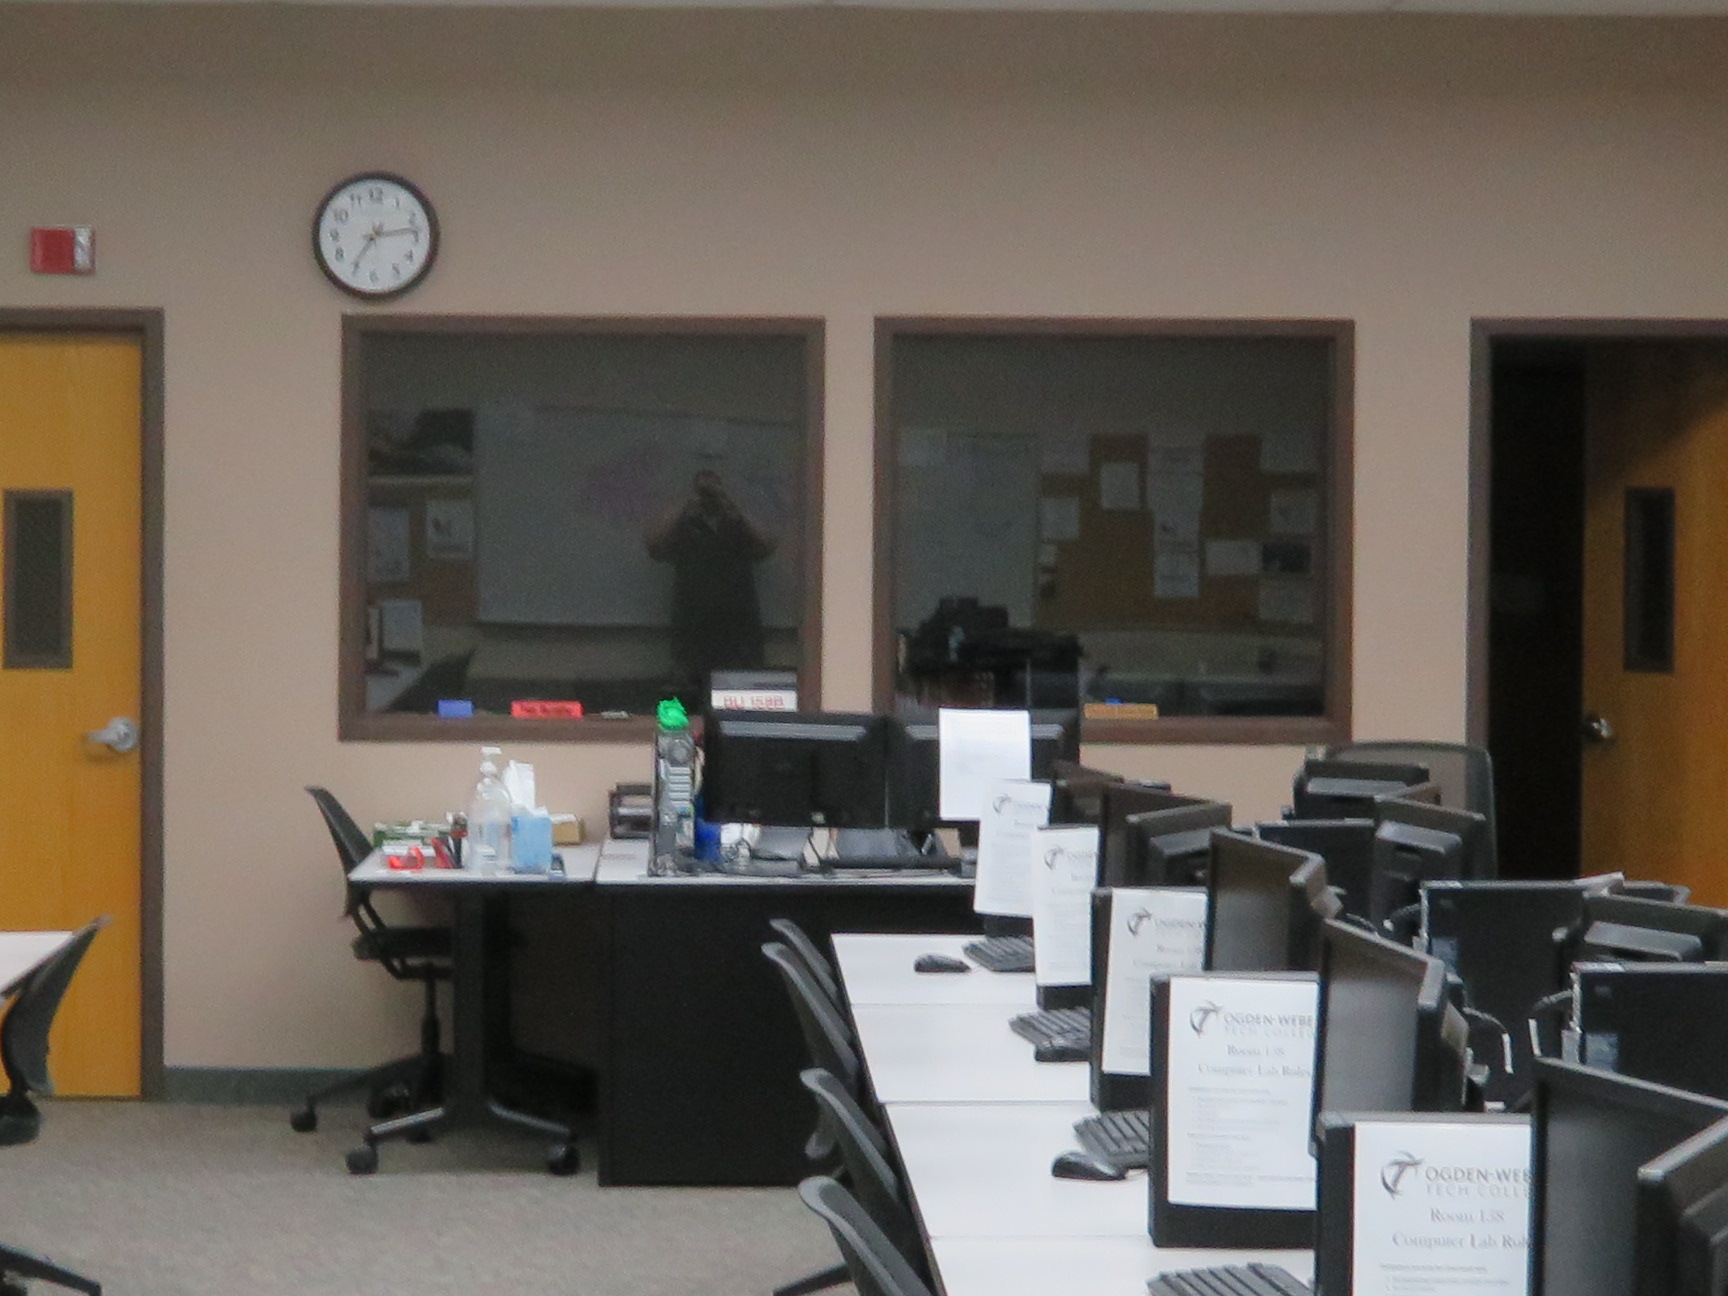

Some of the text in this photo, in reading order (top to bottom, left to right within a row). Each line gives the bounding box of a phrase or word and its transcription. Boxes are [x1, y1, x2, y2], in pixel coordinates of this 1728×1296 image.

[1429, 1207, 1473, 1223] Room
[1391, 1231, 1465, 1250] Computer
[1469, 1233, 1497, 1248] Lab
